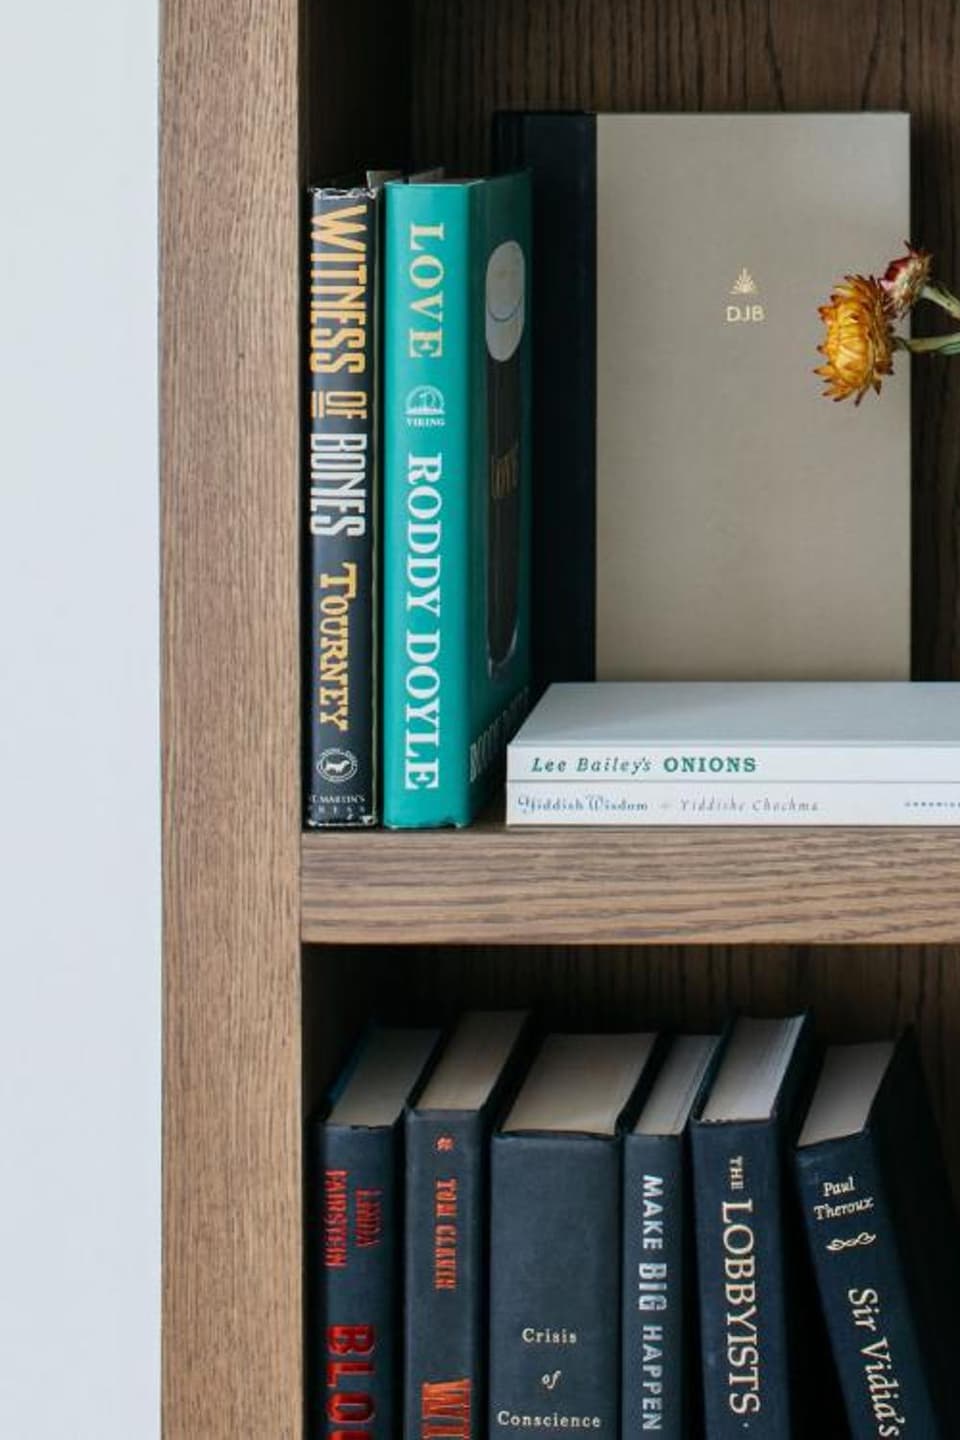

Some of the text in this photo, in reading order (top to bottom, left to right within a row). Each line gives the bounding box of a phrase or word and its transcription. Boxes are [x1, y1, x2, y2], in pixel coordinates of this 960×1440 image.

[408, 221, 445, 359] LOVE
[726, 304, 765, 322] DJB
[309, 204, 367, 537] WITNESS OF BONES
[405, 417, 446, 428] VIKING
[404, 452, 443, 792] RODDY DOYLE
[531, 755, 757, 776] Lee Bailey's ONIONS
[434, 1177, 458, 1218] TOM
[823, 1175, 856, 1197] Paul
[813, 1195, 875, 1221] Theroux
[721, 1156, 762, 1415] THE LOBBYISTS
[638, 1174, 667, 1431] MAKE BIG HAPPEN
[521, 1327, 578, 1344] Crisis
[848, 1288, 906, 1438] Sir Vidia's
[541, 1370, 562, 1390] of
[496, 1410, 602, 1428] Conscience
